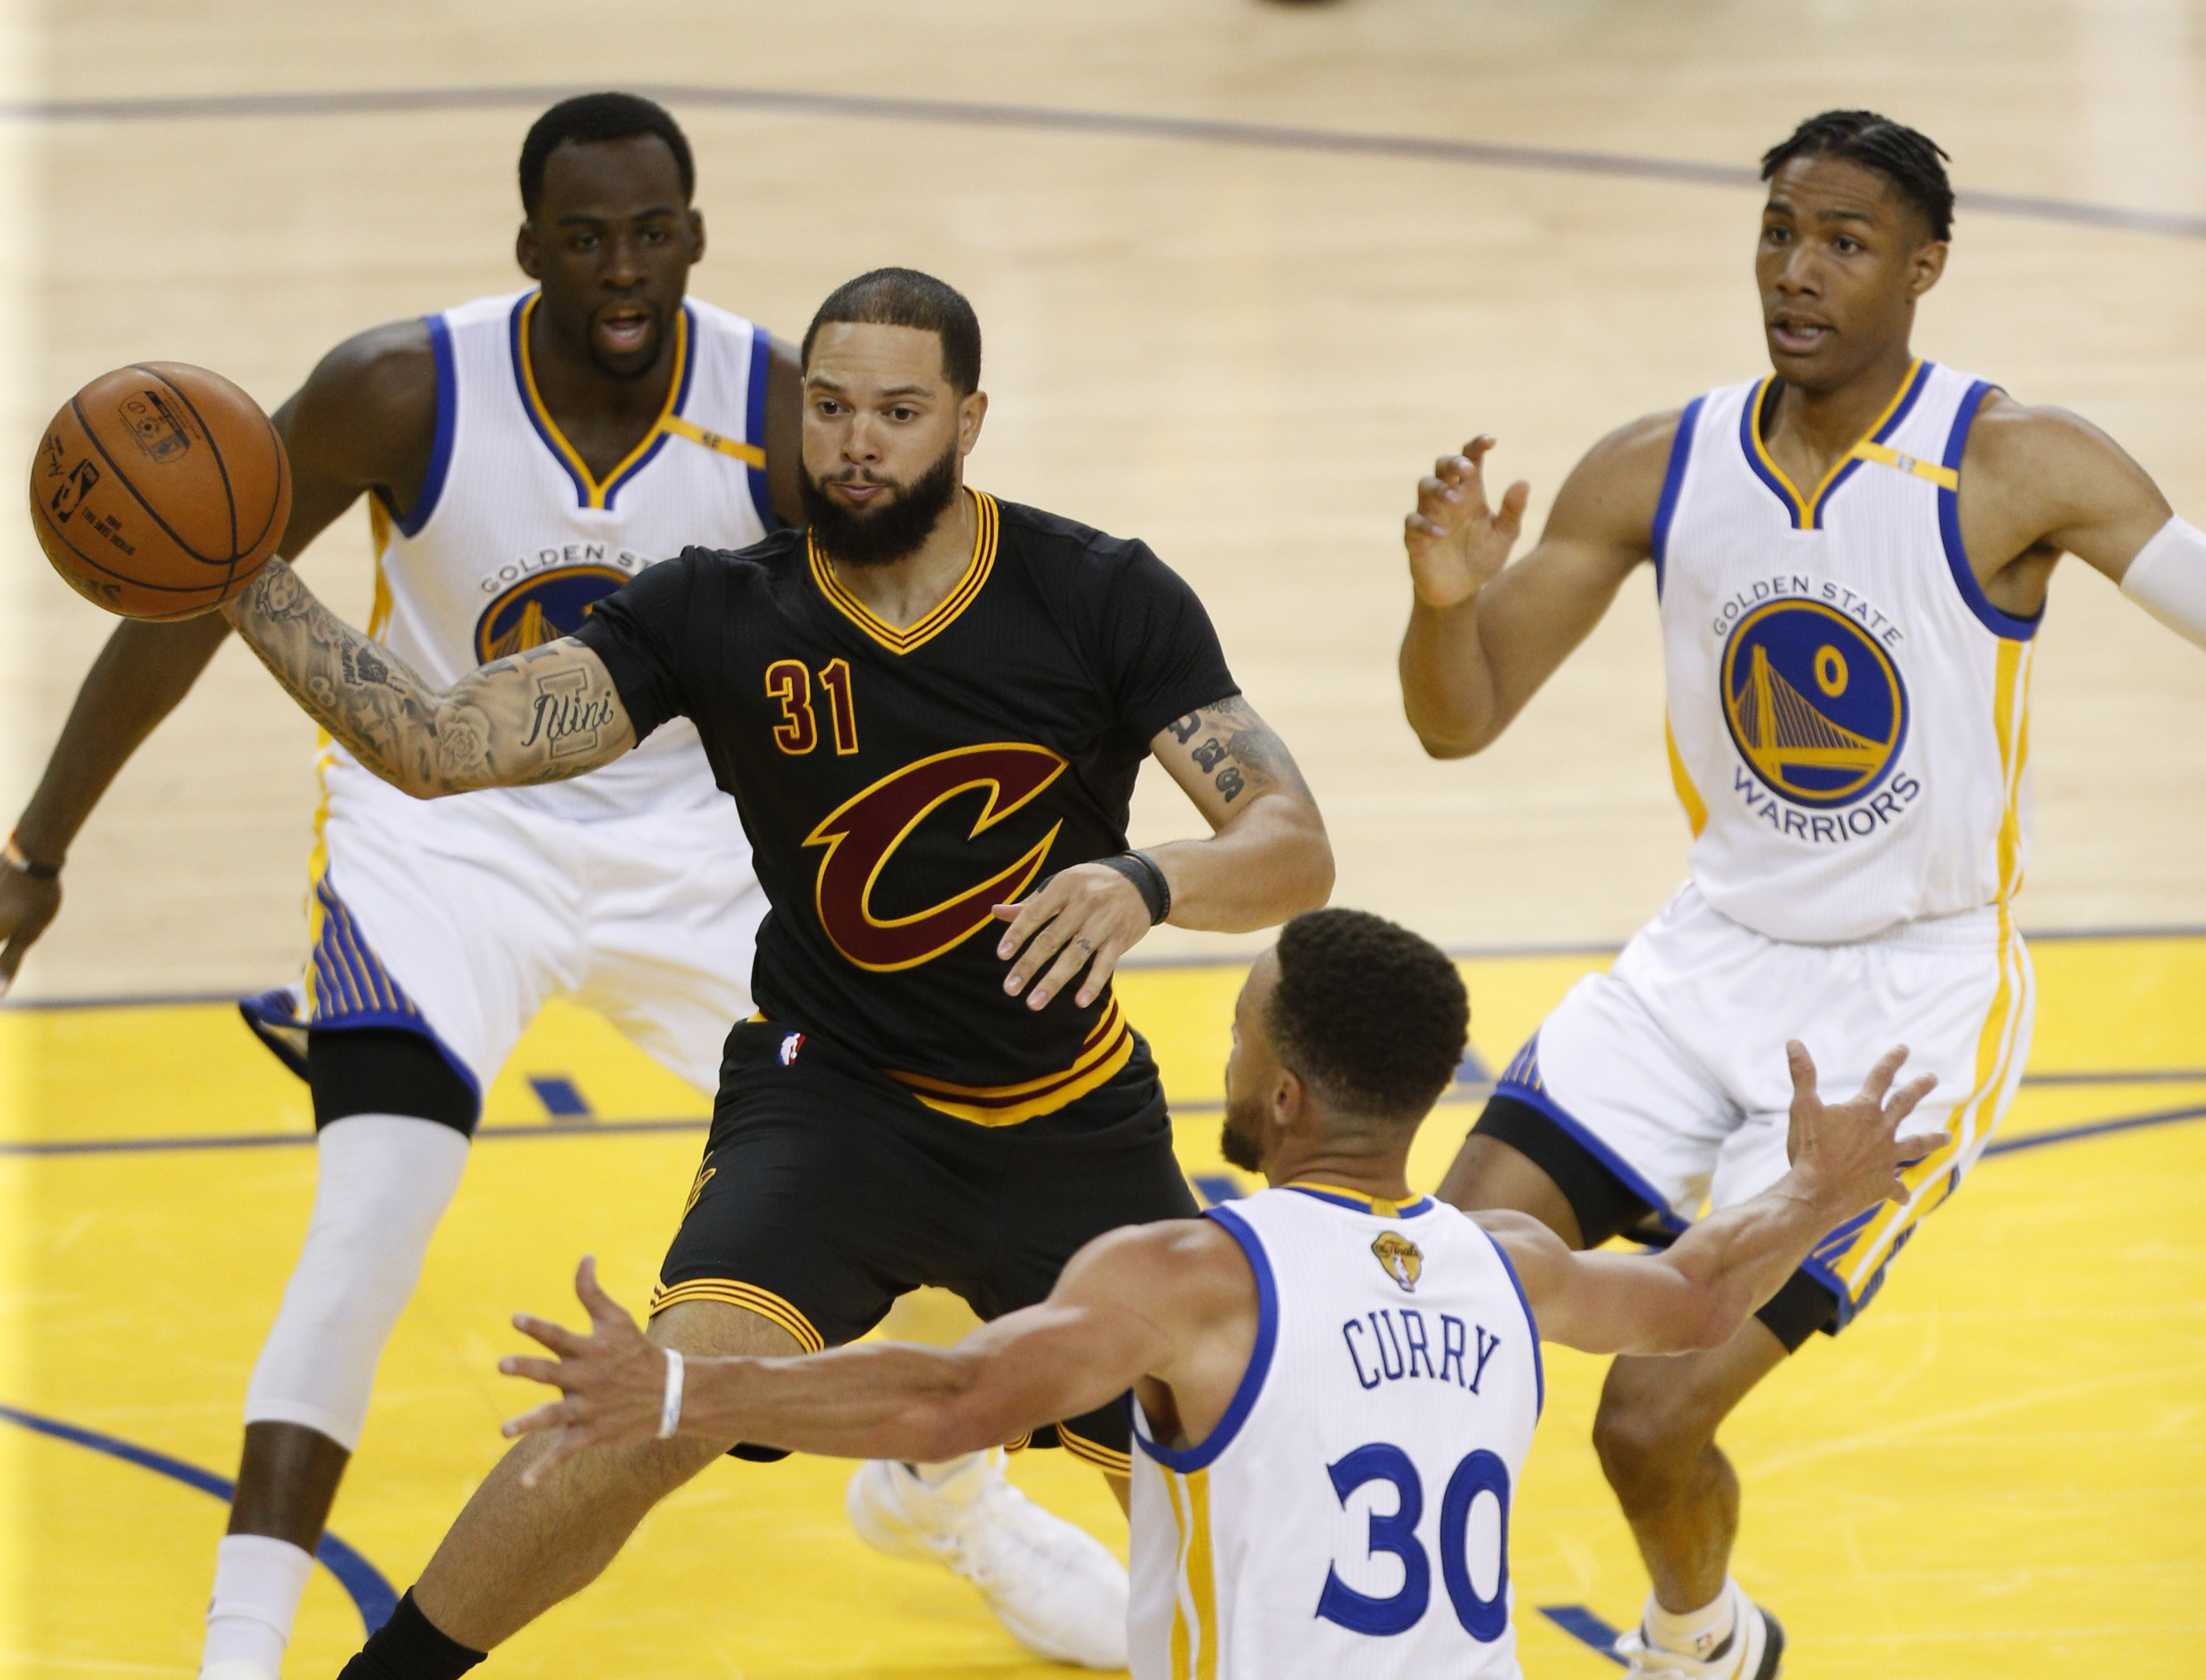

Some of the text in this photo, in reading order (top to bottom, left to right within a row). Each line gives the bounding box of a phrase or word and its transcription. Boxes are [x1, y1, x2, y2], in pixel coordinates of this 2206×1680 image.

[481, 544, 604, 594] GOLDEN
[1713, 576, 1903, 647] GOLDEN STATE
[765, 657, 859, 756] 31
[1814, 643, 1849, 698] 0
[1734, 763, 1921, 843] WARRIORS
[1343, 1309, 1500, 1395] CURRY
[1314, 1442, 1510, 1642] 30
